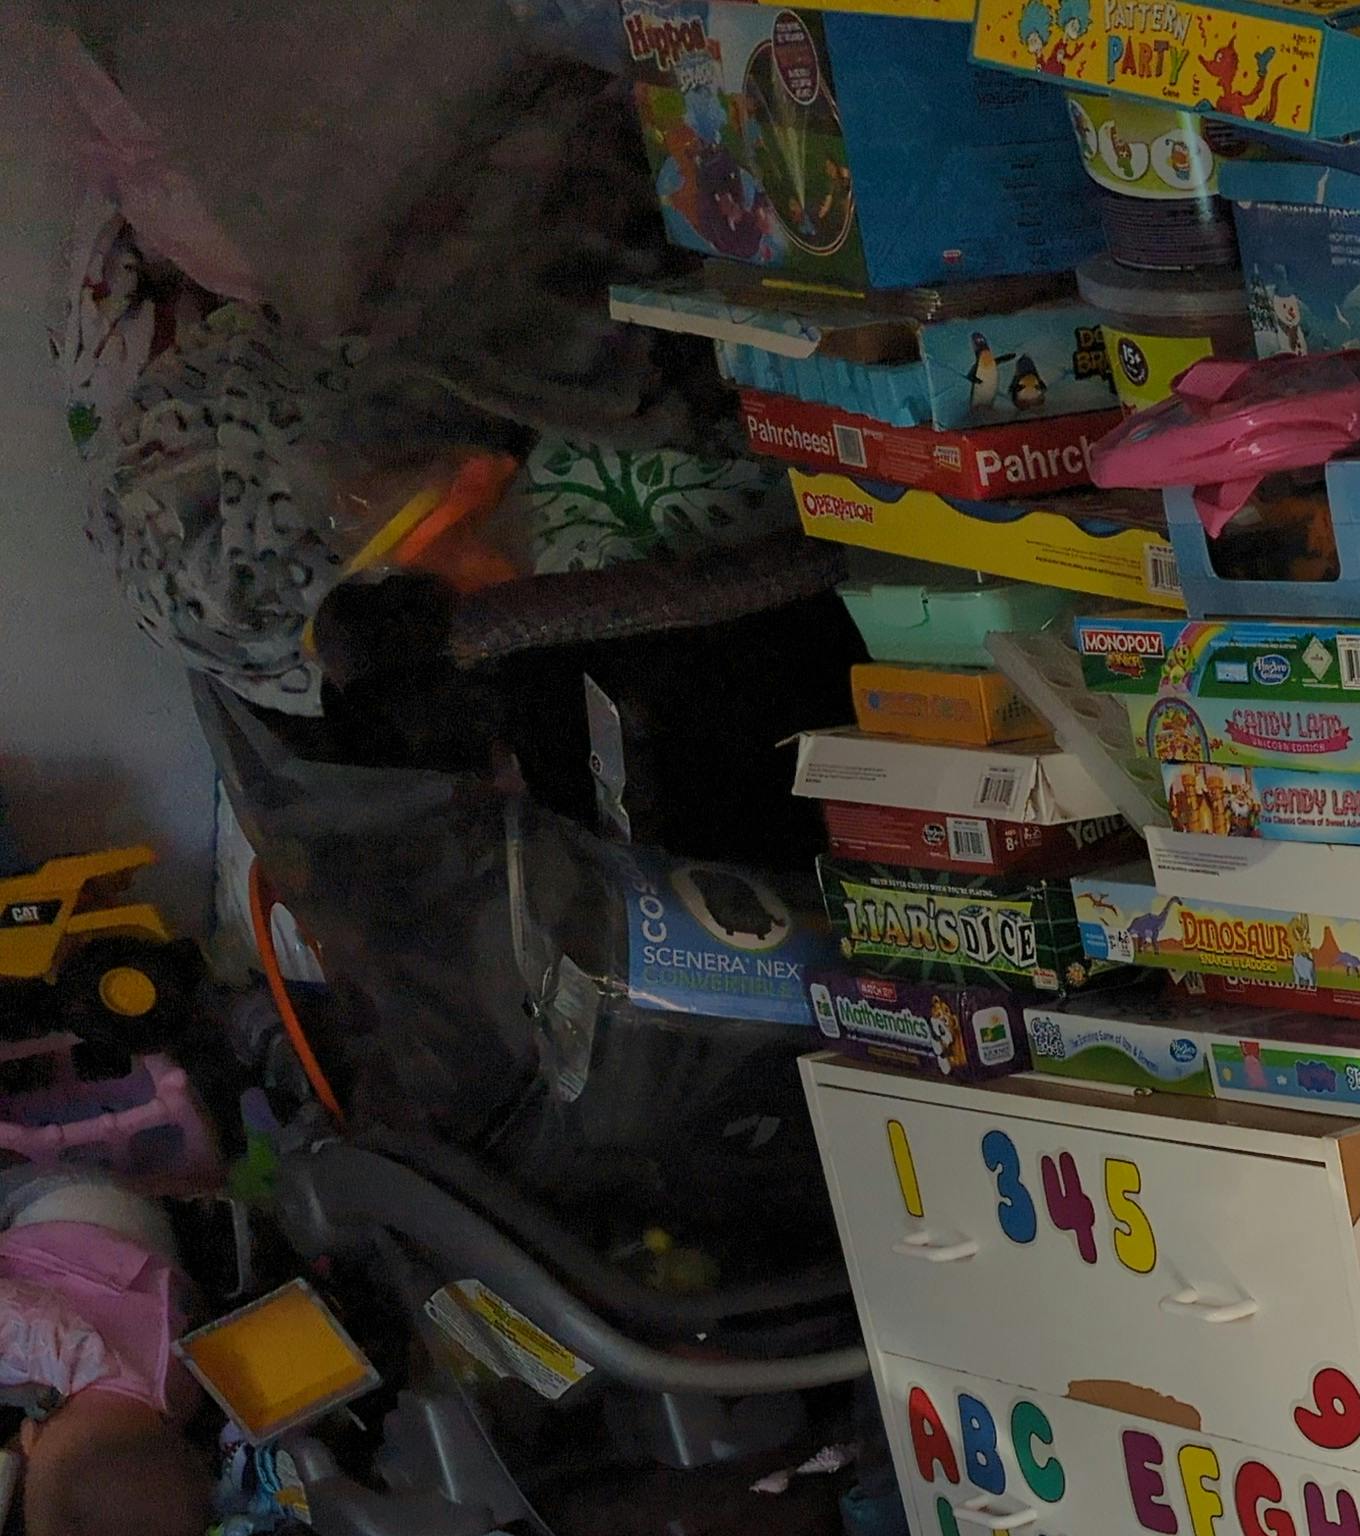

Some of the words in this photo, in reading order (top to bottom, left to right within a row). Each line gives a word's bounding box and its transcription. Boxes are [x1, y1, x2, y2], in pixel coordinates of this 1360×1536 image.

[1104, 0, 1192, 45] PATTERN
[1107, 36, 1189, 85] PARTY
[747, 414, 835, 458] Pahrcheesi
[975, 435, 1098, 488] Pahrch
[802, 491, 875, 524] OPERATION
[1084, 633, 1162, 655] MONOPOLY
[1233, 708, 1291, 737] CANDY
[1297, 710, 1342, 739] LAND
[1263, 786, 1327, 815] CANDY
[1006, 836, 1019, 851] 8+
[11, 905, 40, 923] CAT
[844, 897, 960, 954] LIAR'S
[960, 914, 1037, 961] DICE
[1180, 910, 1296, 960] DINOSAUR
[643, 946, 744, 974] SCENERA
[841, 1001, 929, 1039] Mathematics
